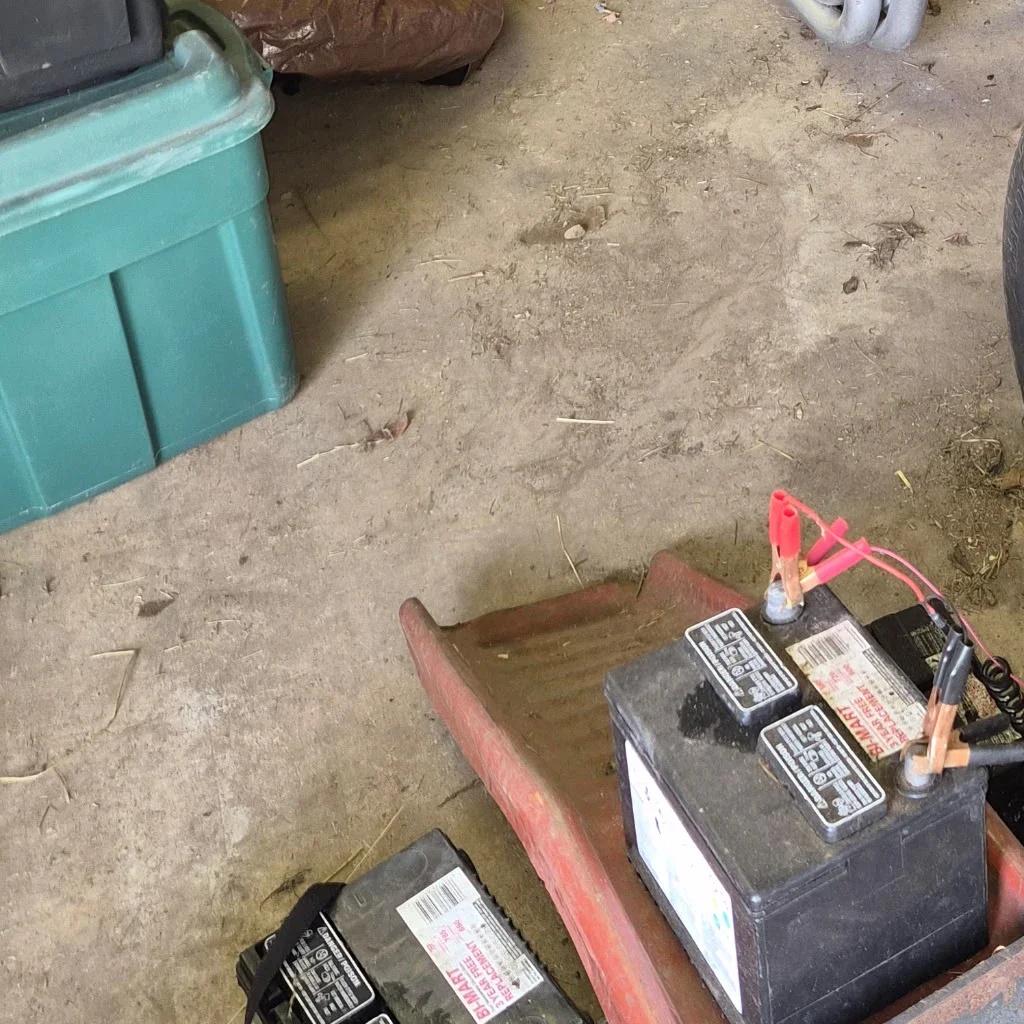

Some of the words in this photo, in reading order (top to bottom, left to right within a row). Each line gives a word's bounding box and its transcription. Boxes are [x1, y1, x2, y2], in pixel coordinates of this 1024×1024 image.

[853, 694, 875, 720] FREE
[856, 680, 908, 746] REPLACEMENT
[836, 700, 884, 759] BI-MART
[870, 716, 893, 743] YEAR
[461, 954, 482, 979] FREE
[465, 937, 514, 1003] REPLACEMENT
[445, 963, 490, 1022] BI-MART
[478, 976, 500, 1003] YEAR
[494, 999, 504, 1009] 3
